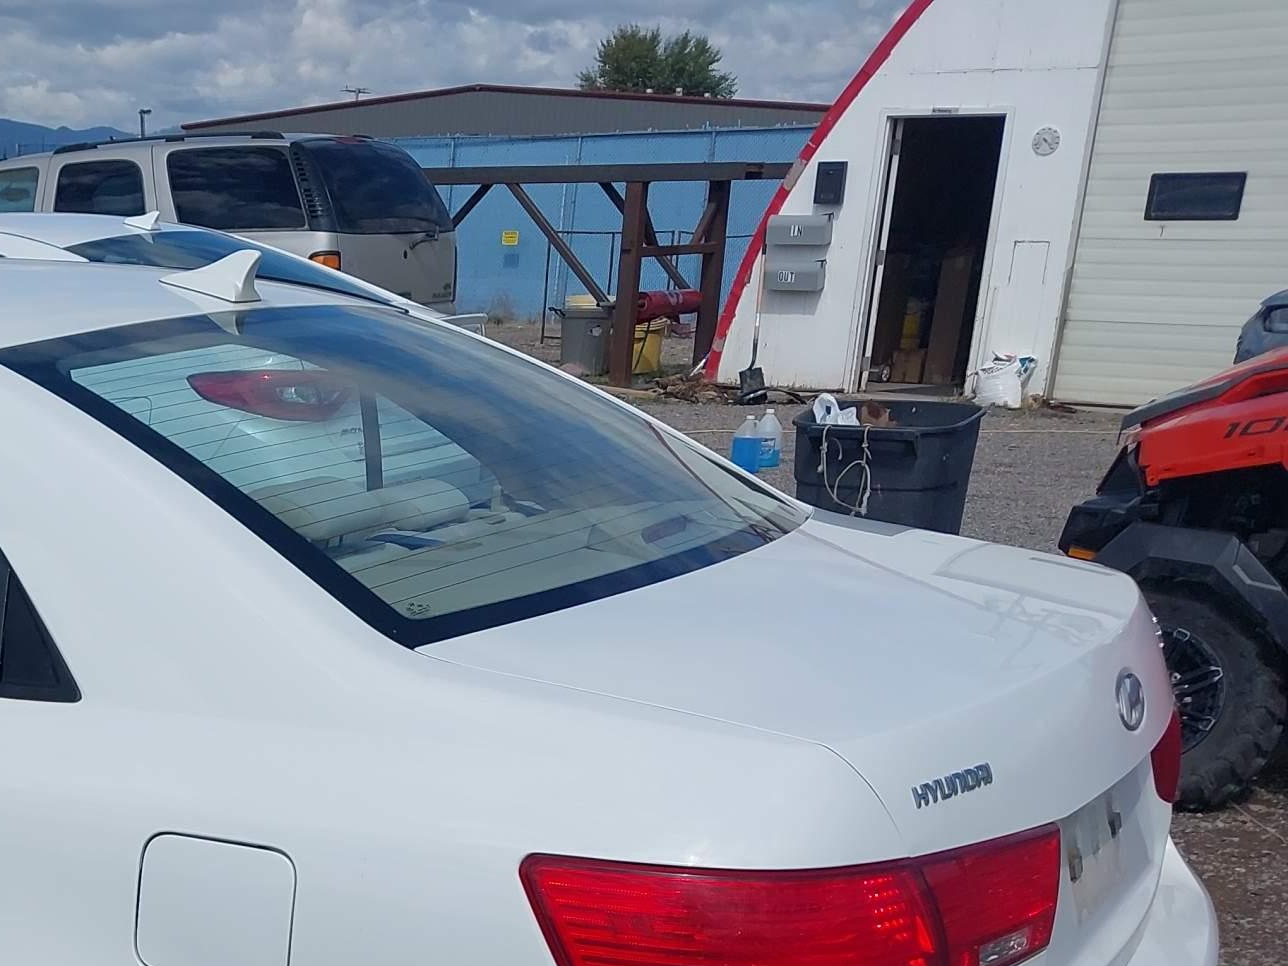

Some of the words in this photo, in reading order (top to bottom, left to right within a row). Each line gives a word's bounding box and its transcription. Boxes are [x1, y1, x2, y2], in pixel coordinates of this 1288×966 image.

[779, 271, 795, 282] OUT
[1224, 416, 1288, 439] 10
[912, 762, 993, 809] HYUNDAI
